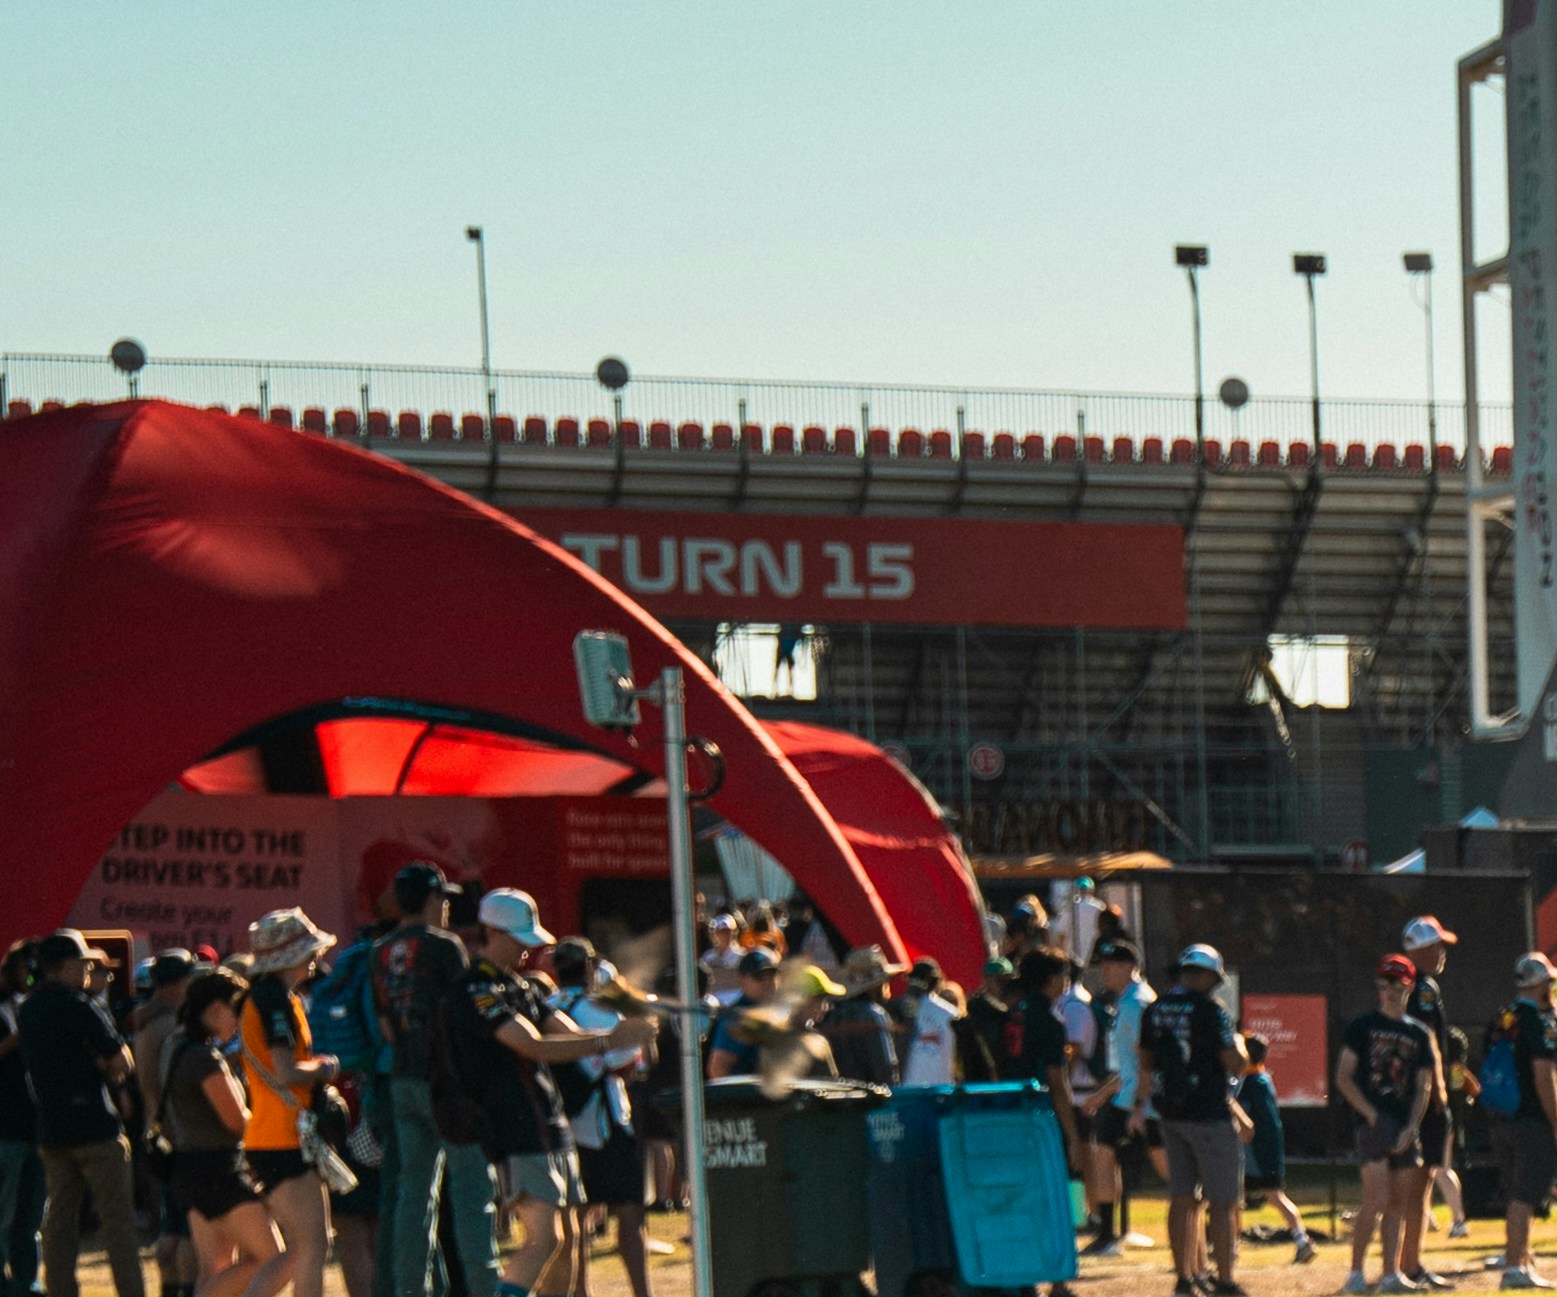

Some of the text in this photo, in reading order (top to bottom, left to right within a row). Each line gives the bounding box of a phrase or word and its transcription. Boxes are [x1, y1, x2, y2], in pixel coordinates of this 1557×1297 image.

[561, 531, 916, 601] TURN 15
[119, 824, 306, 858] TEP INTO THE
[102, 855, 304, 890] DRIVER'S SEAT
[702, 1117, 757, 1145] ENUE
